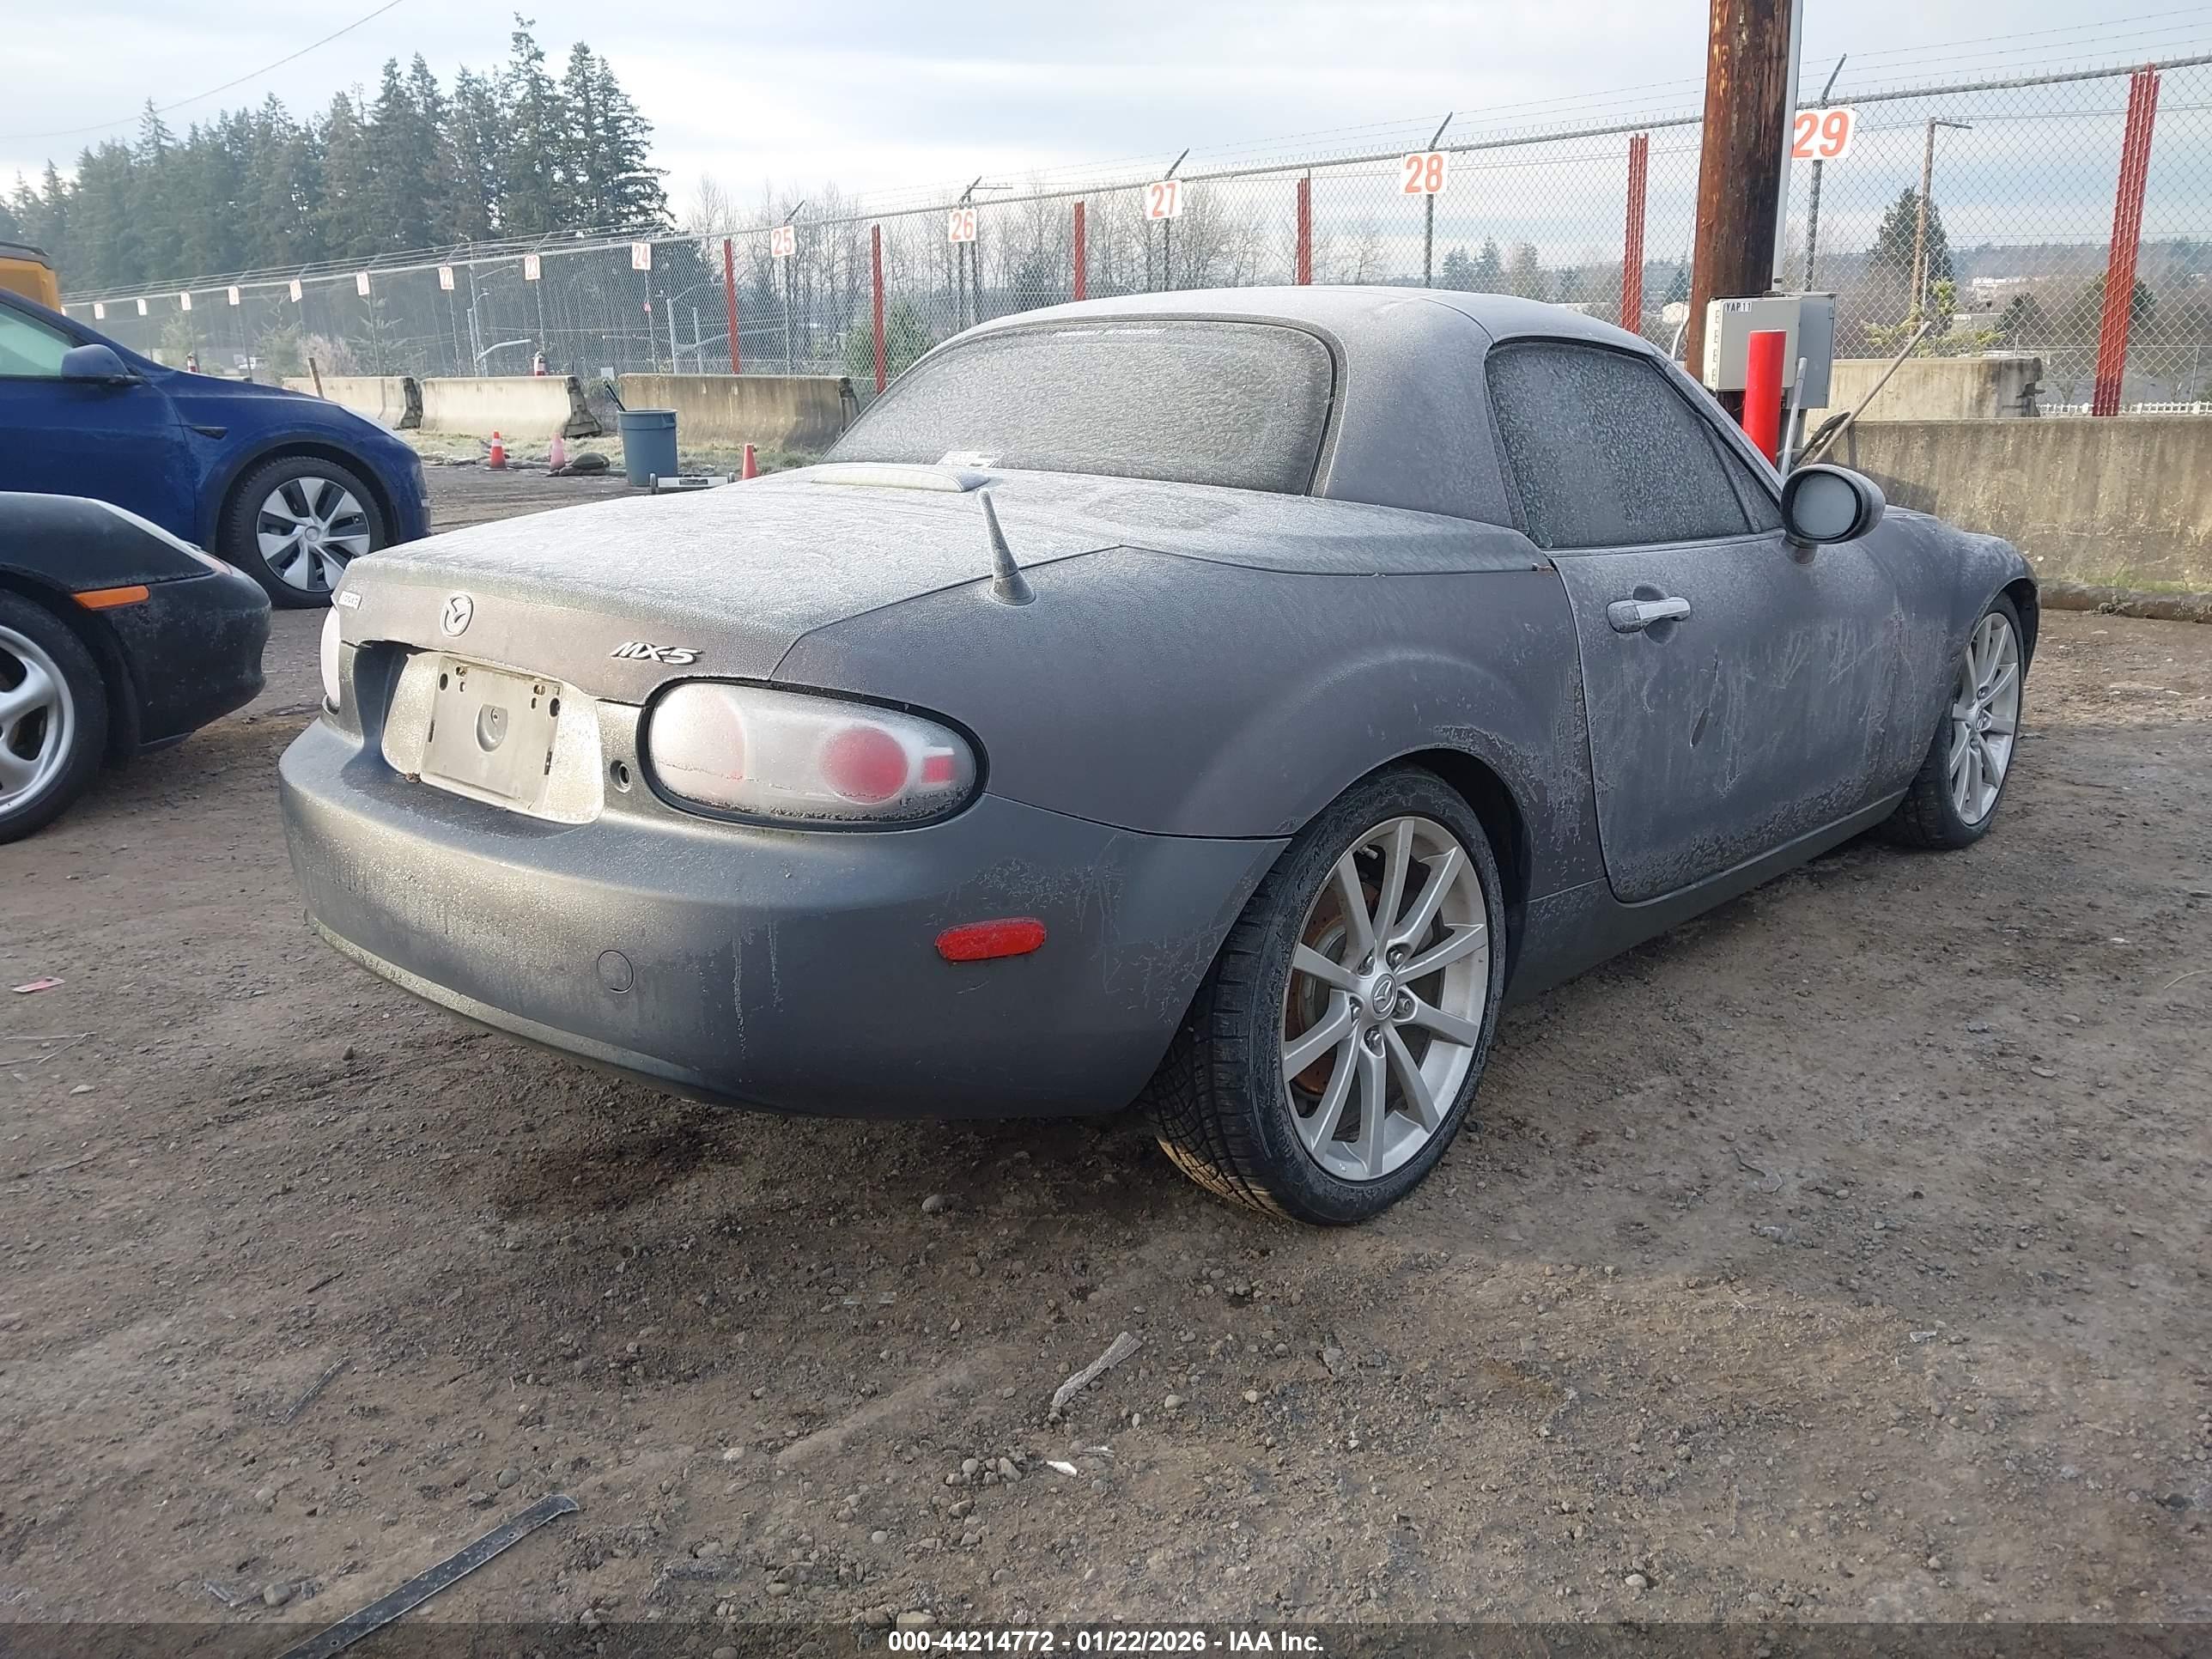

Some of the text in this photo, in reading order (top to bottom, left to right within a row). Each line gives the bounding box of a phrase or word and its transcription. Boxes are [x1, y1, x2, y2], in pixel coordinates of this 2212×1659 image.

[1793, 111, 1849, 158] 29
[1405, 155, 1443, 193] 28
[1152, 182, 1176, 217] 27
[951, 211, 974, 240] 26
[773, 228, 792, 255] 25
[526, 257, 538, 279] 23
[635, 245, 649, 268] 24
[441, 269, 453, 288] 22
[611, 641, 703, 665] MX-5
